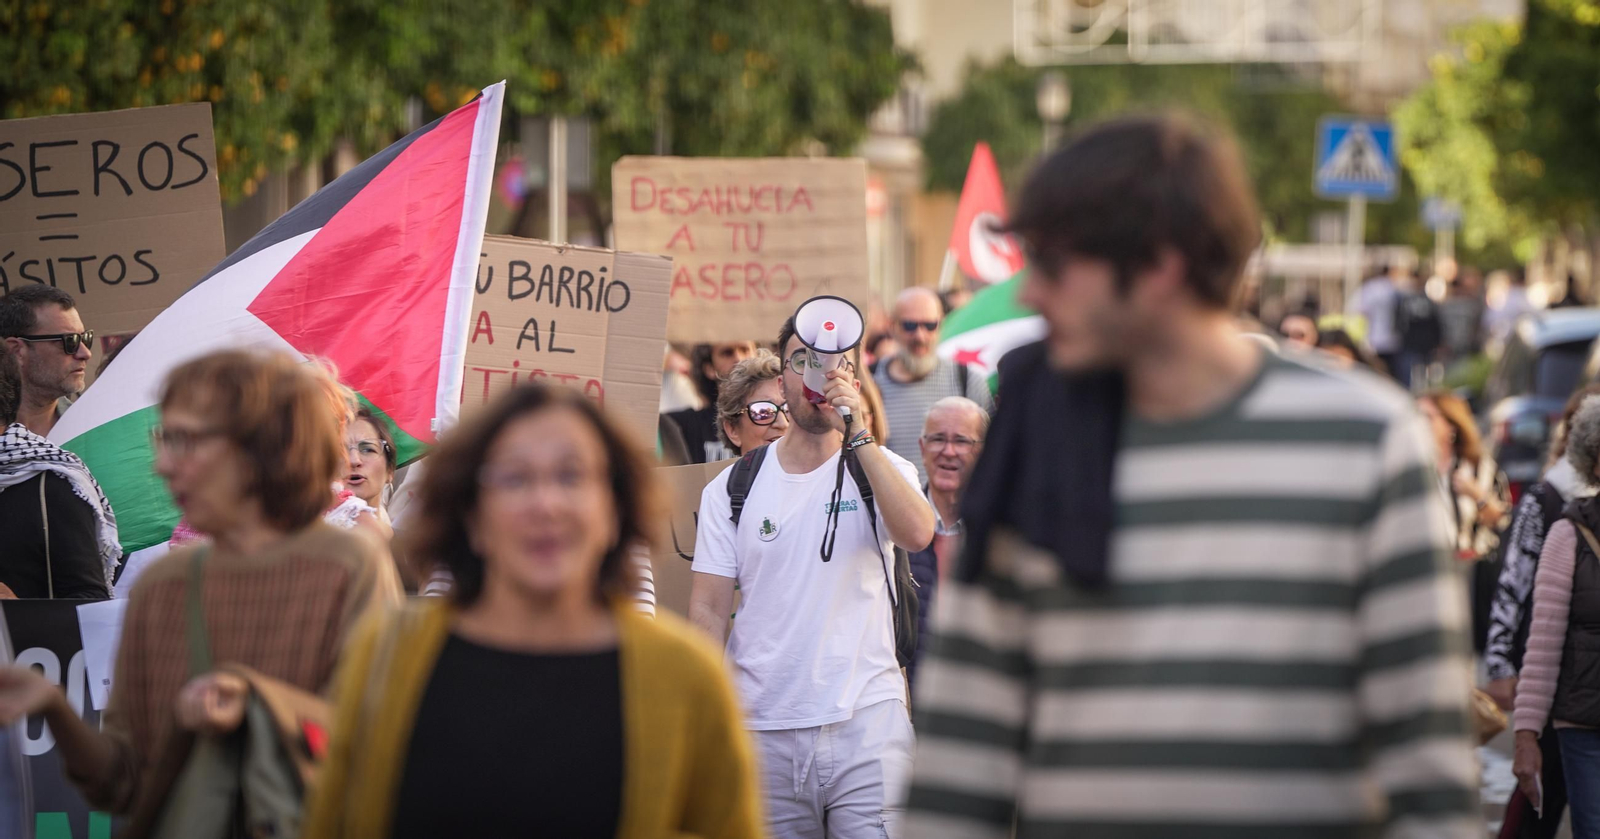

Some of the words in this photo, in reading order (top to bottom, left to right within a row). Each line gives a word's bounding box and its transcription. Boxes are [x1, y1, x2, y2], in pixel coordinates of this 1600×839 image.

[630, 177, 814, 215] DESAHUCIA
[666, 224, 695, 251] A
[725, 221, 764, 252] TU
[516, 317, 575, 353] AL
